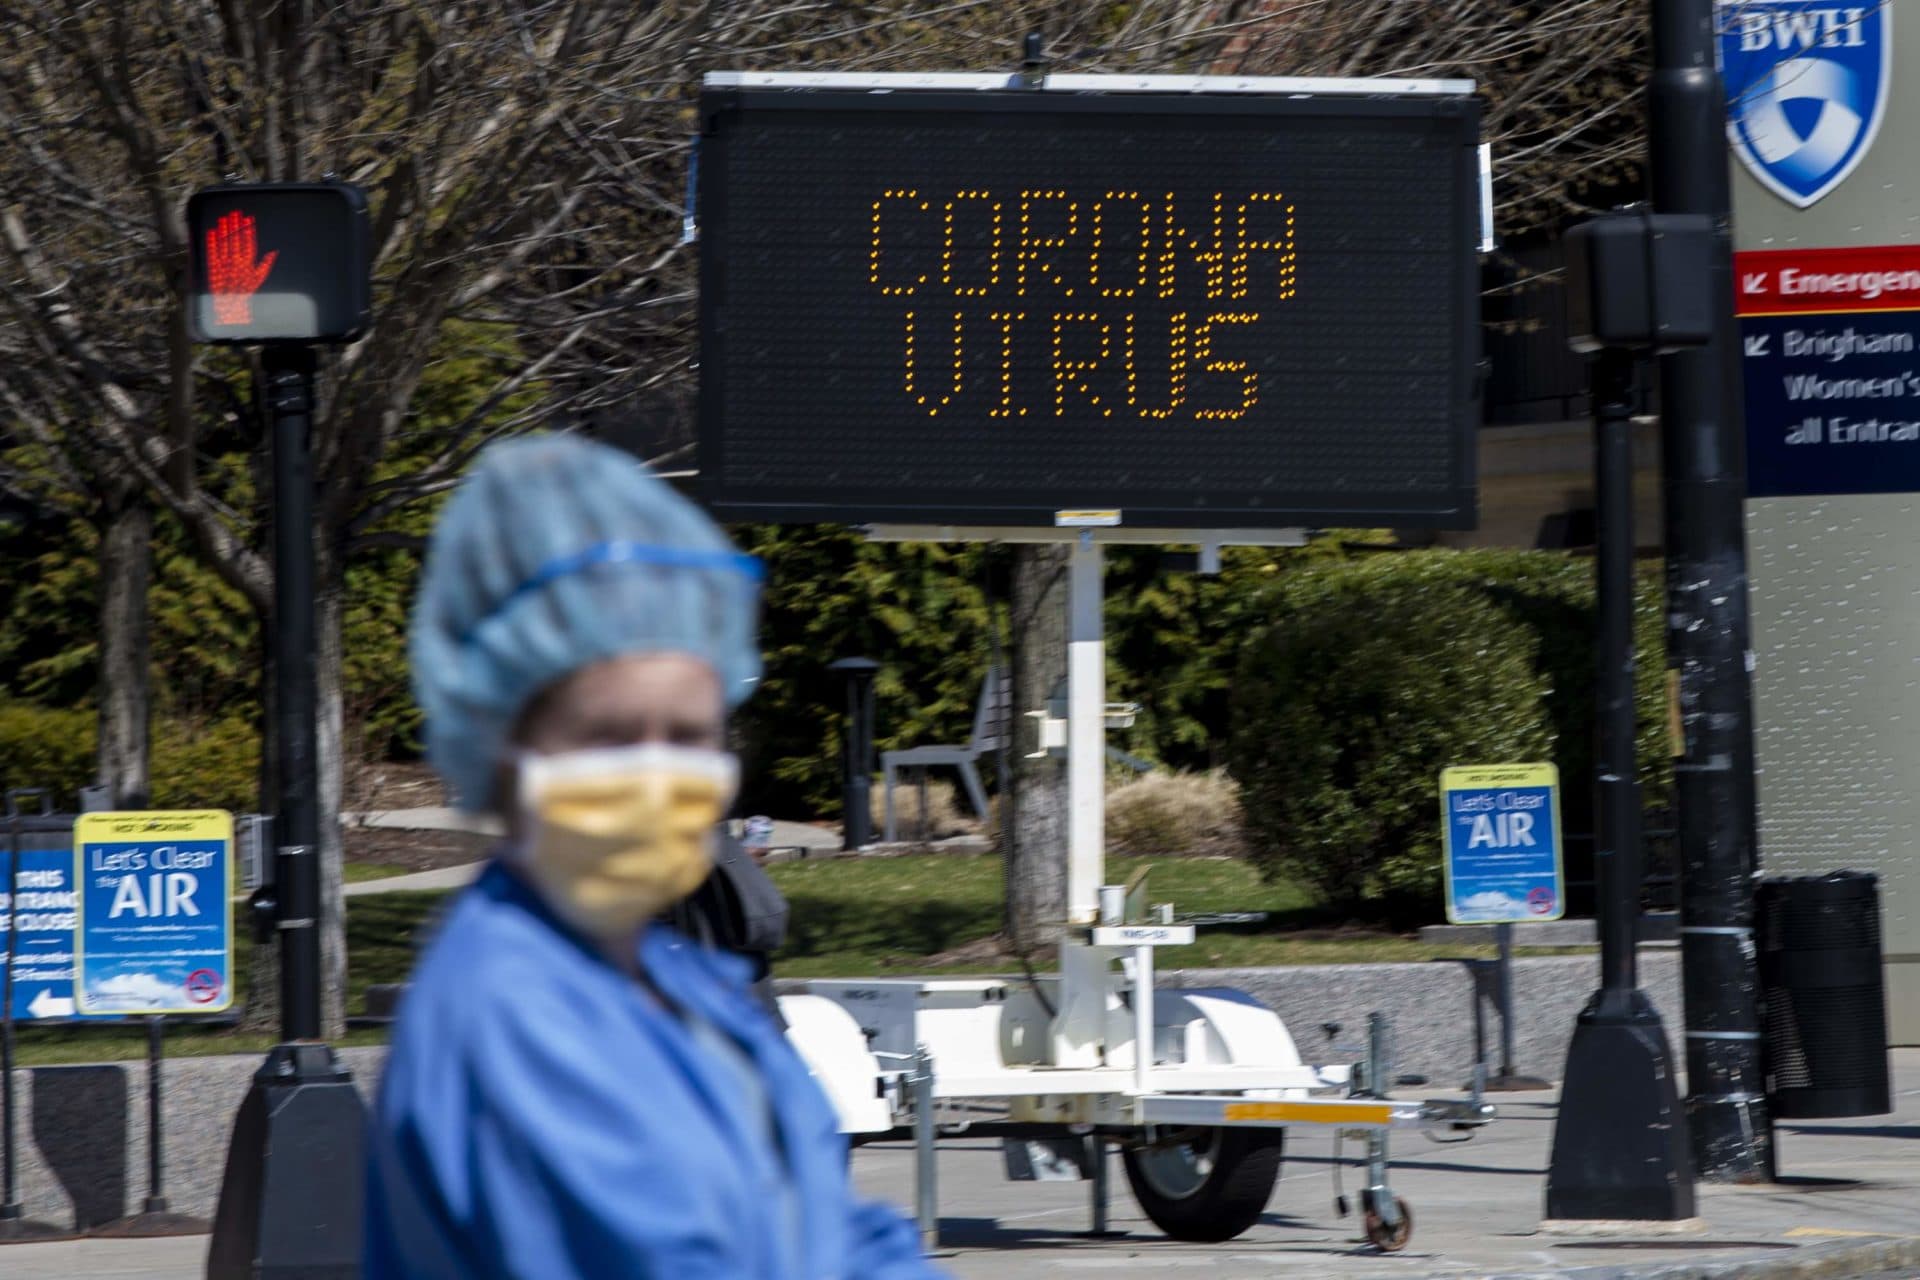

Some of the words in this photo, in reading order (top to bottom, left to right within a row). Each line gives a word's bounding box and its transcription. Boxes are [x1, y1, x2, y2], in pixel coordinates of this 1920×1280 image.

[1739, 8, 1867, 51] BWH
[870, 189, 1296, 300] CORONA
[1783, 327, 1914, 362] Brigham
[905, 311, 1260, 420] VIRUS
[1783, 371, 1920, 400] Women's
[1784, 417, 1823, 444] all
[1453, 793, 1496, 813] Let's
[1497, 792, 1546, 811] Clear
[1468, 812, 1537, 849] AIR
[92, 848, 147, 871] Let's
[150, 846, 217, 870] Clear
[109, 872, 201, 919] AIR
